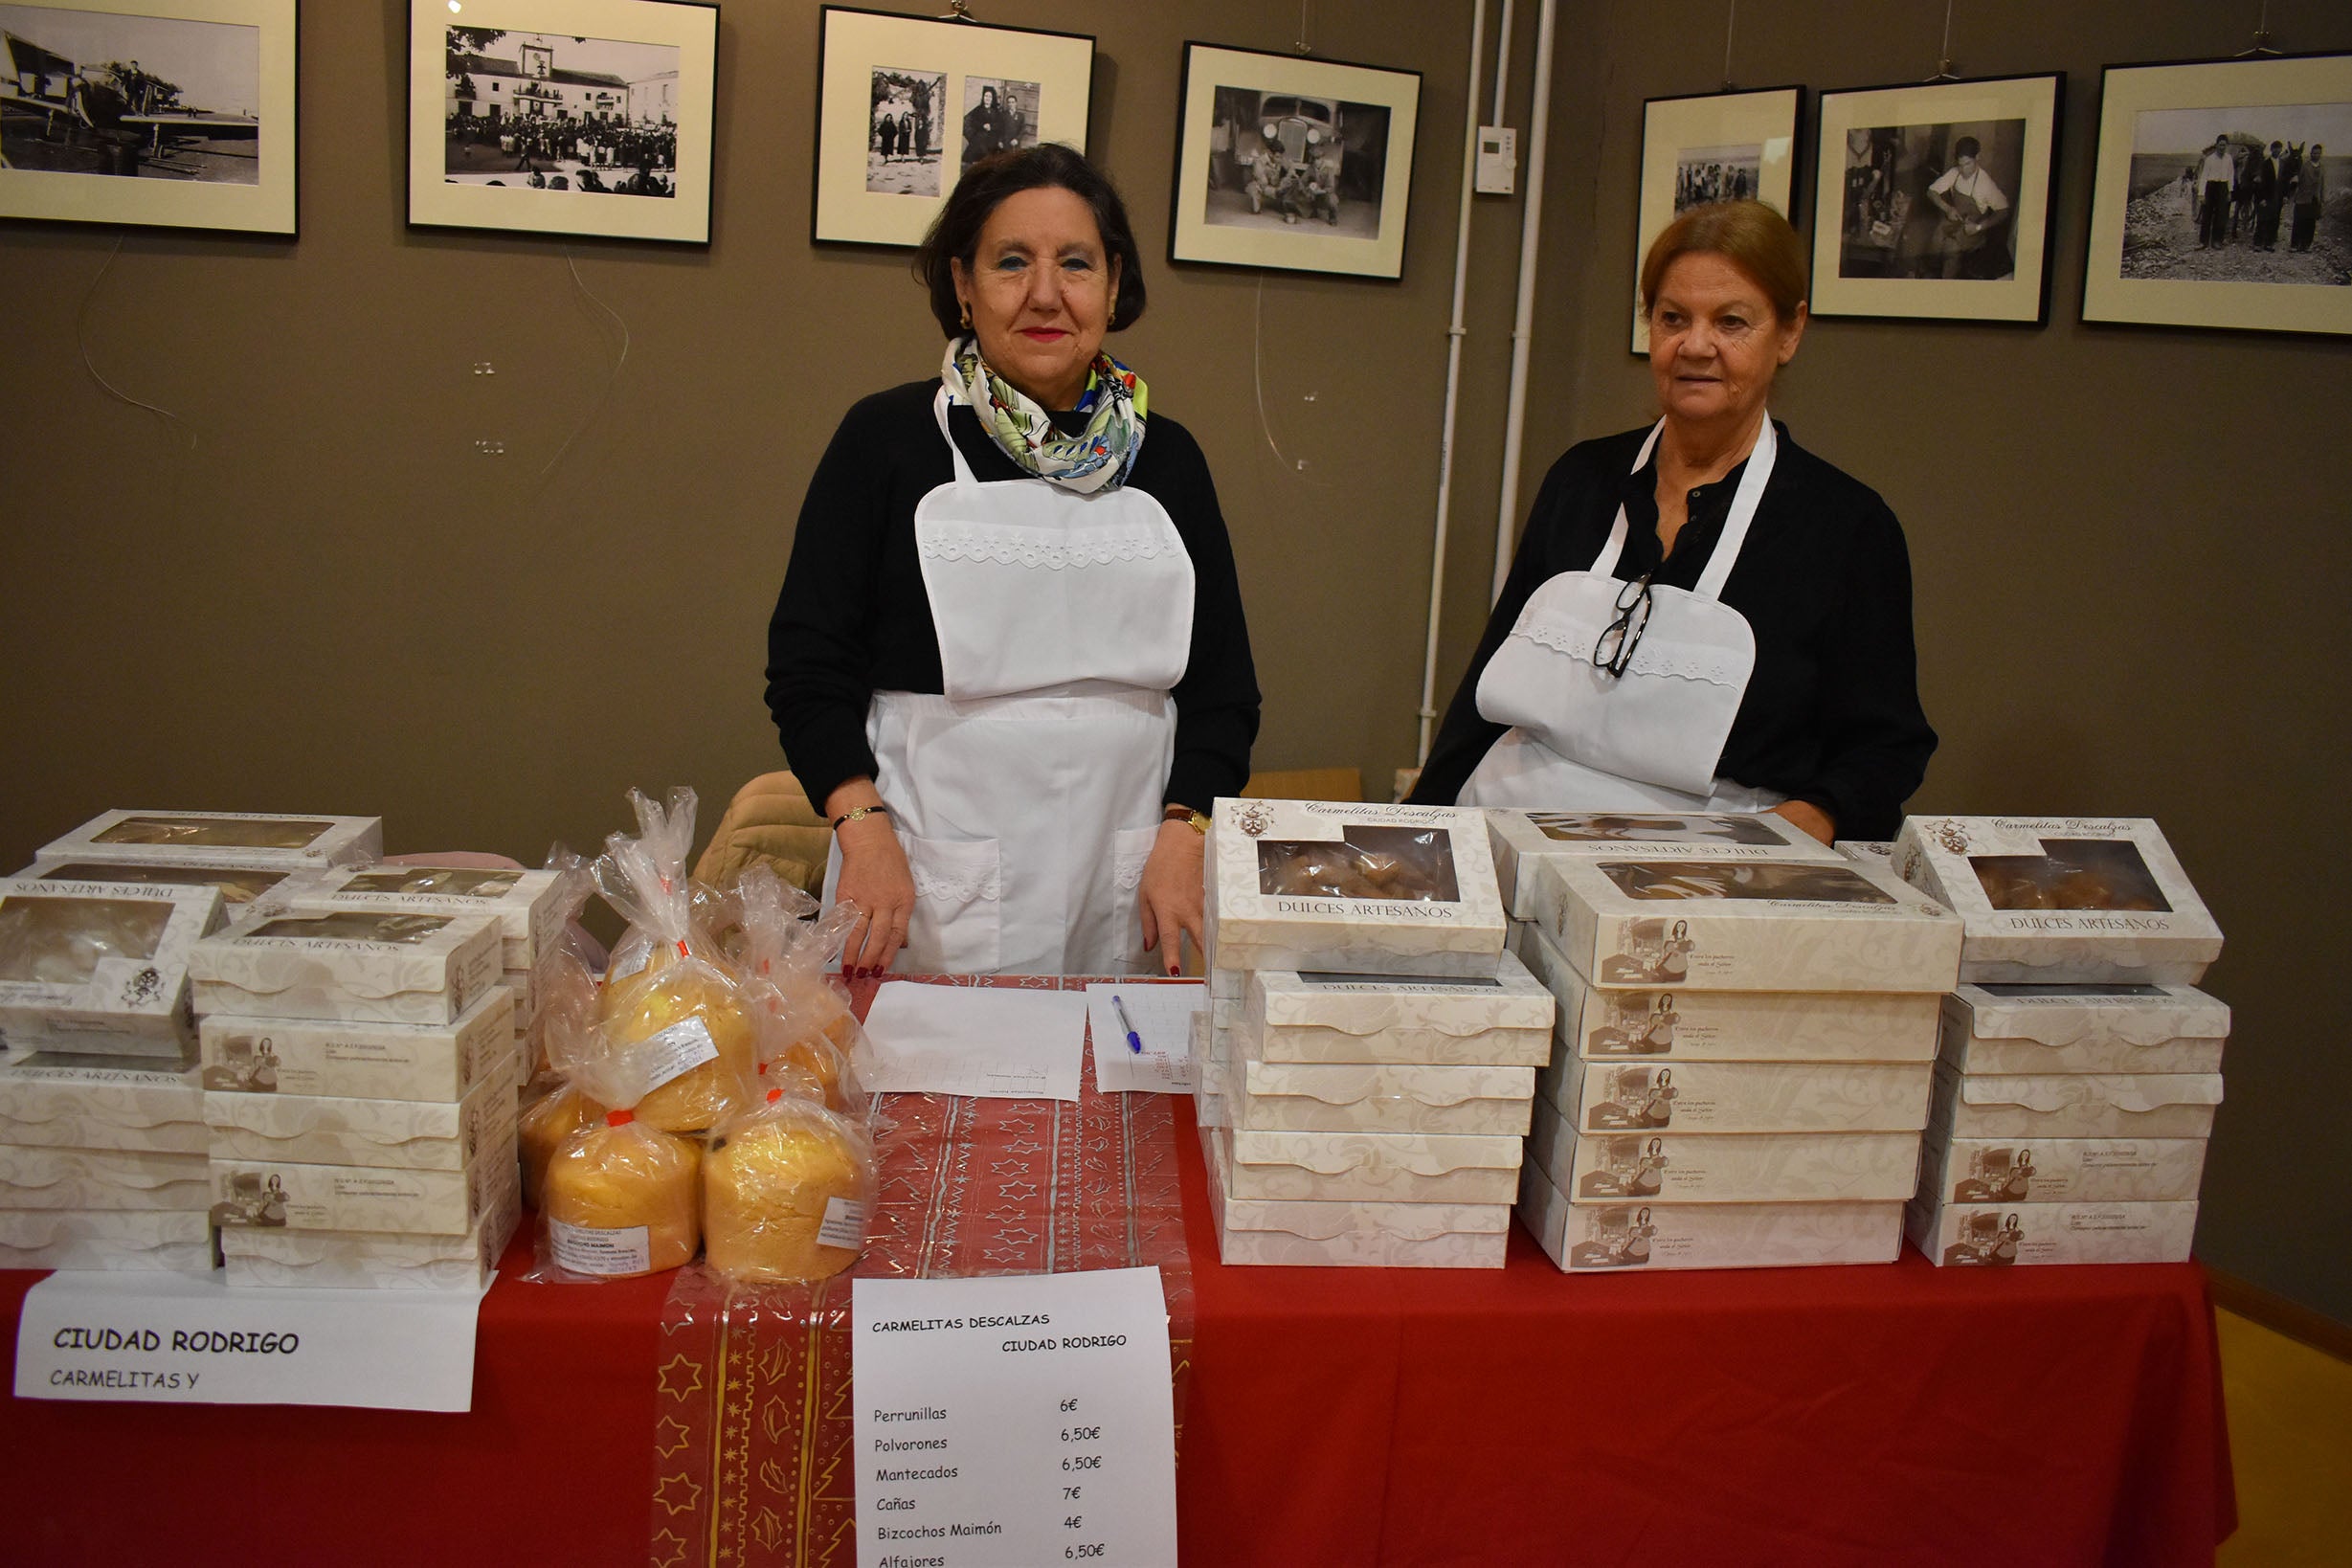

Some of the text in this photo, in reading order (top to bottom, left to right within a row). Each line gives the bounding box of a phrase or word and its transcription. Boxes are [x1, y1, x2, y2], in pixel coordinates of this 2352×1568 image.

[1305, 801, 1457, 821] Carmelitas Descalzas
[1991, 818, 2133, 834] Carmelitas Descalzas
[1278, 900, 1453, 919] DULCES ARTESANOS
[2010, 917, 2170, 931] DULCES ARTESANOS
[872, 1313, 1050, 1333] CARMELITAS DESCALZAS
[54, 1328, 300, 1355] CIUDAD RODRIGO
[1001, 1334, 1127, 1353] CIUDAD RODRIGO
[50, 1369, 200, 1390] CARMELITAS Y
[873, 1398, 1078, 1422] Perrunillas 6€
[874, 1426, 1101, 1452] Polvorones 6,50€
[875, 1456, 1102, 1482] Mantecados 6,50€
[876, 1486, 1081, 1512] Cañas 7€
[877, 1520, 1002, 1540] Bizcochos Maimón
[1064, 1515, 1083, 1530] 4€
[879, 1543, 1105, 1568] Alfajores 6,50€
